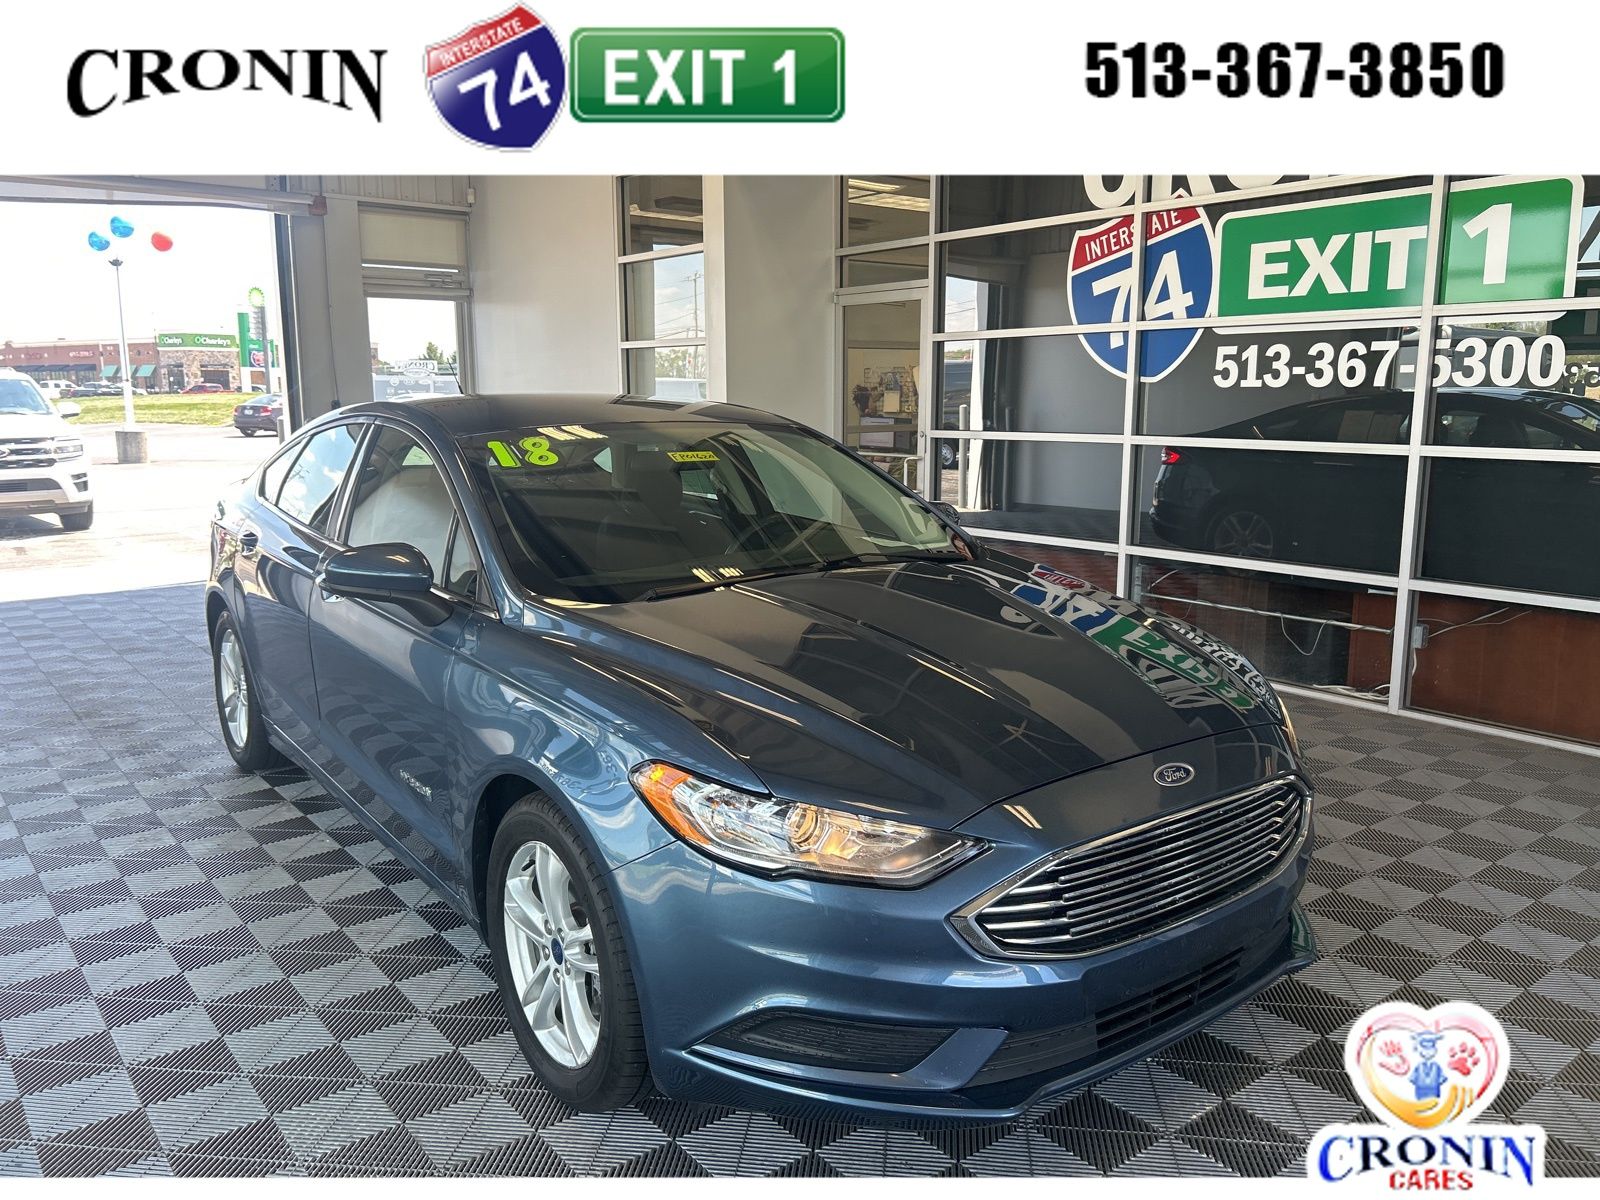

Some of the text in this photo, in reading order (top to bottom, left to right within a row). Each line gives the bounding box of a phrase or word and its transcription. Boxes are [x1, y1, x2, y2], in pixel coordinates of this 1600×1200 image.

[1085, 210, 1182, 262] INTERATE
[1248, 203, 1512, 299] EXIT 1
[1091, 249, 1194, 350] 74
[1213, 335, 1567, 388] 513-367-5300
[487, 435, 560, 468] 18
[1163, 767, 1187, 782] Ford
